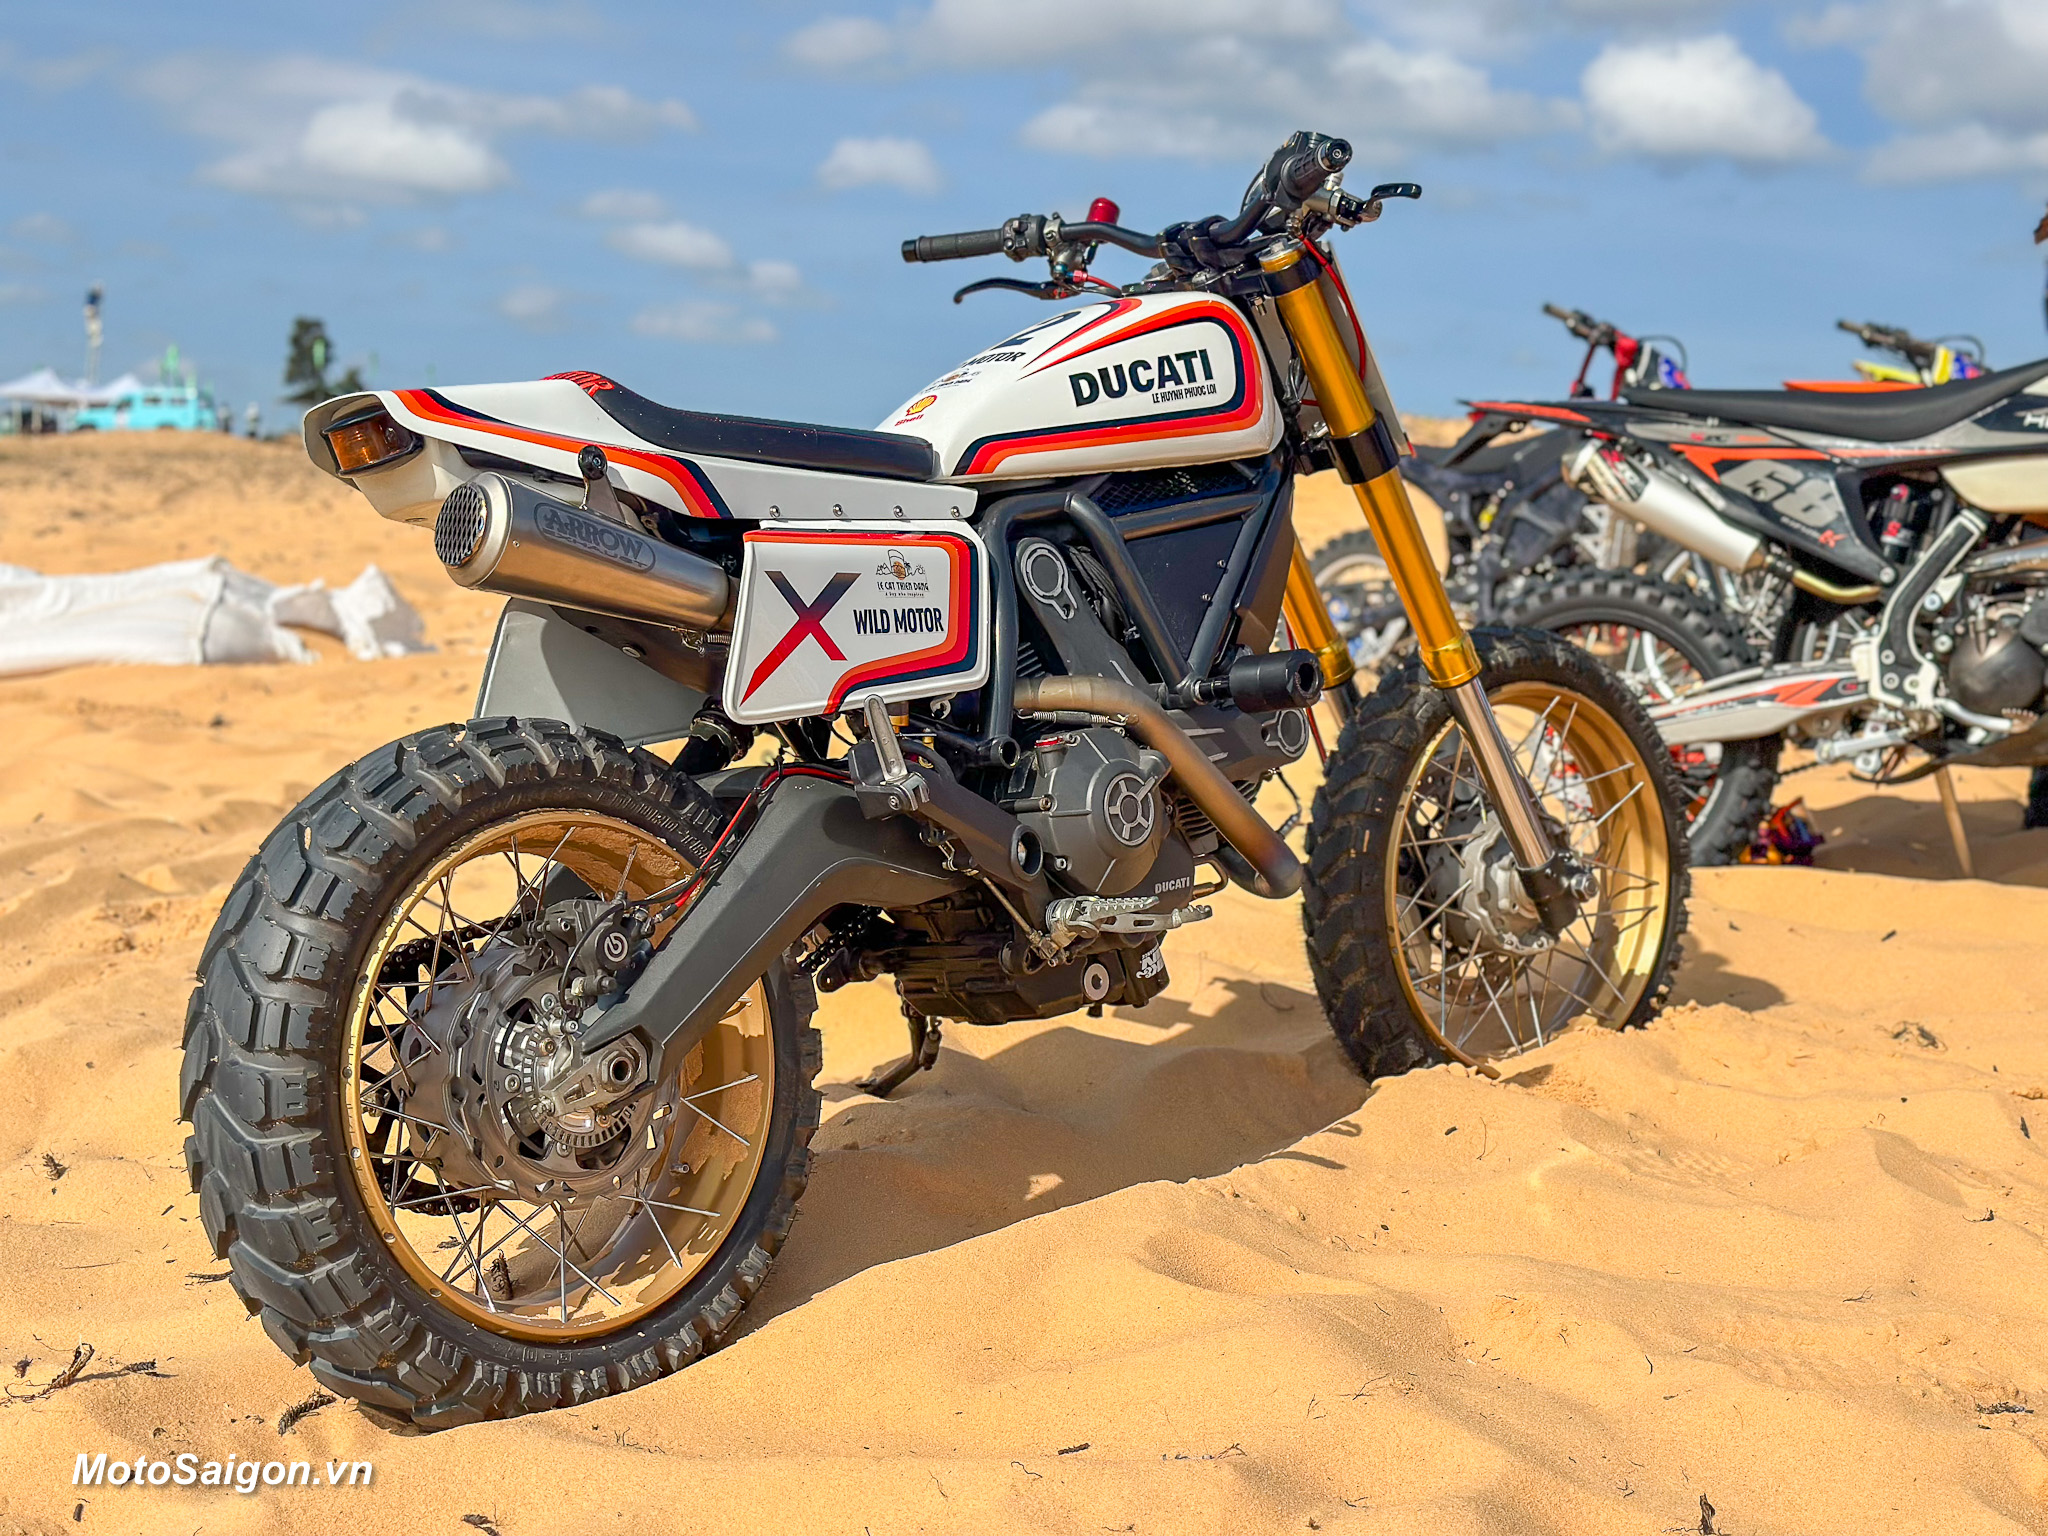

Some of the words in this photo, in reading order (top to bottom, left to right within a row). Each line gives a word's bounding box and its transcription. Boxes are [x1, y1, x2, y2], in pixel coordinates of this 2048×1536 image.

[1068, 348, 1214, 408] DUCATI
[1151, 392, 1161, 404] LE
[1160, 388, 1184, 403] HUYNH
[1206, 383, 1217, 395] LOI
[543, 507, 644, 561] ARROW
[853, 608, 891, 635] WILD
[893, 607, 945, 634] MOTOR
[1154, 876, 1191, 895] DUCATI
